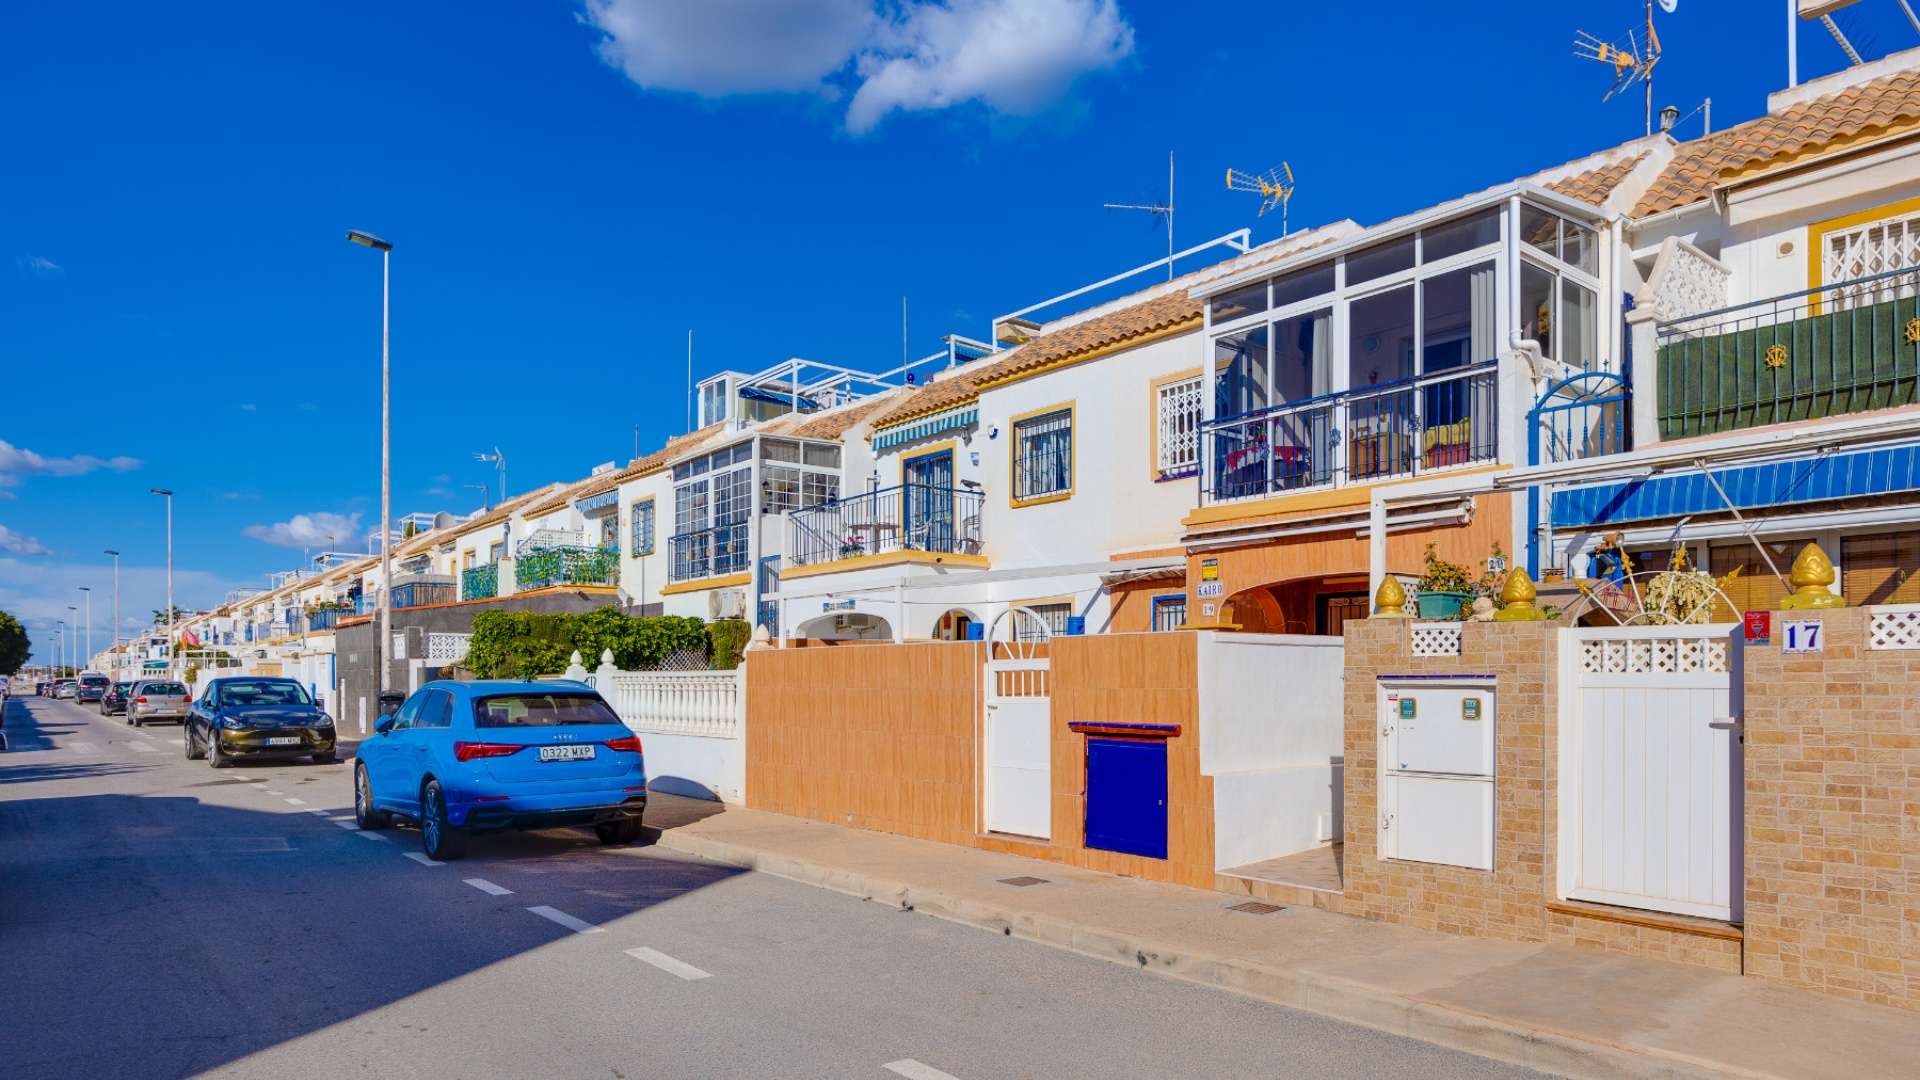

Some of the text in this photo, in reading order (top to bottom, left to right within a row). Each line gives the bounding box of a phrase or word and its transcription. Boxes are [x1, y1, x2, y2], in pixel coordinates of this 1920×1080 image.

[1197, 584, 1222, 596] KAIRO
[1204, 605, 1214, 614] 19
[1787, 624, 1821, 649] 17
[542, 746, 591, 758] 0322 MXP
